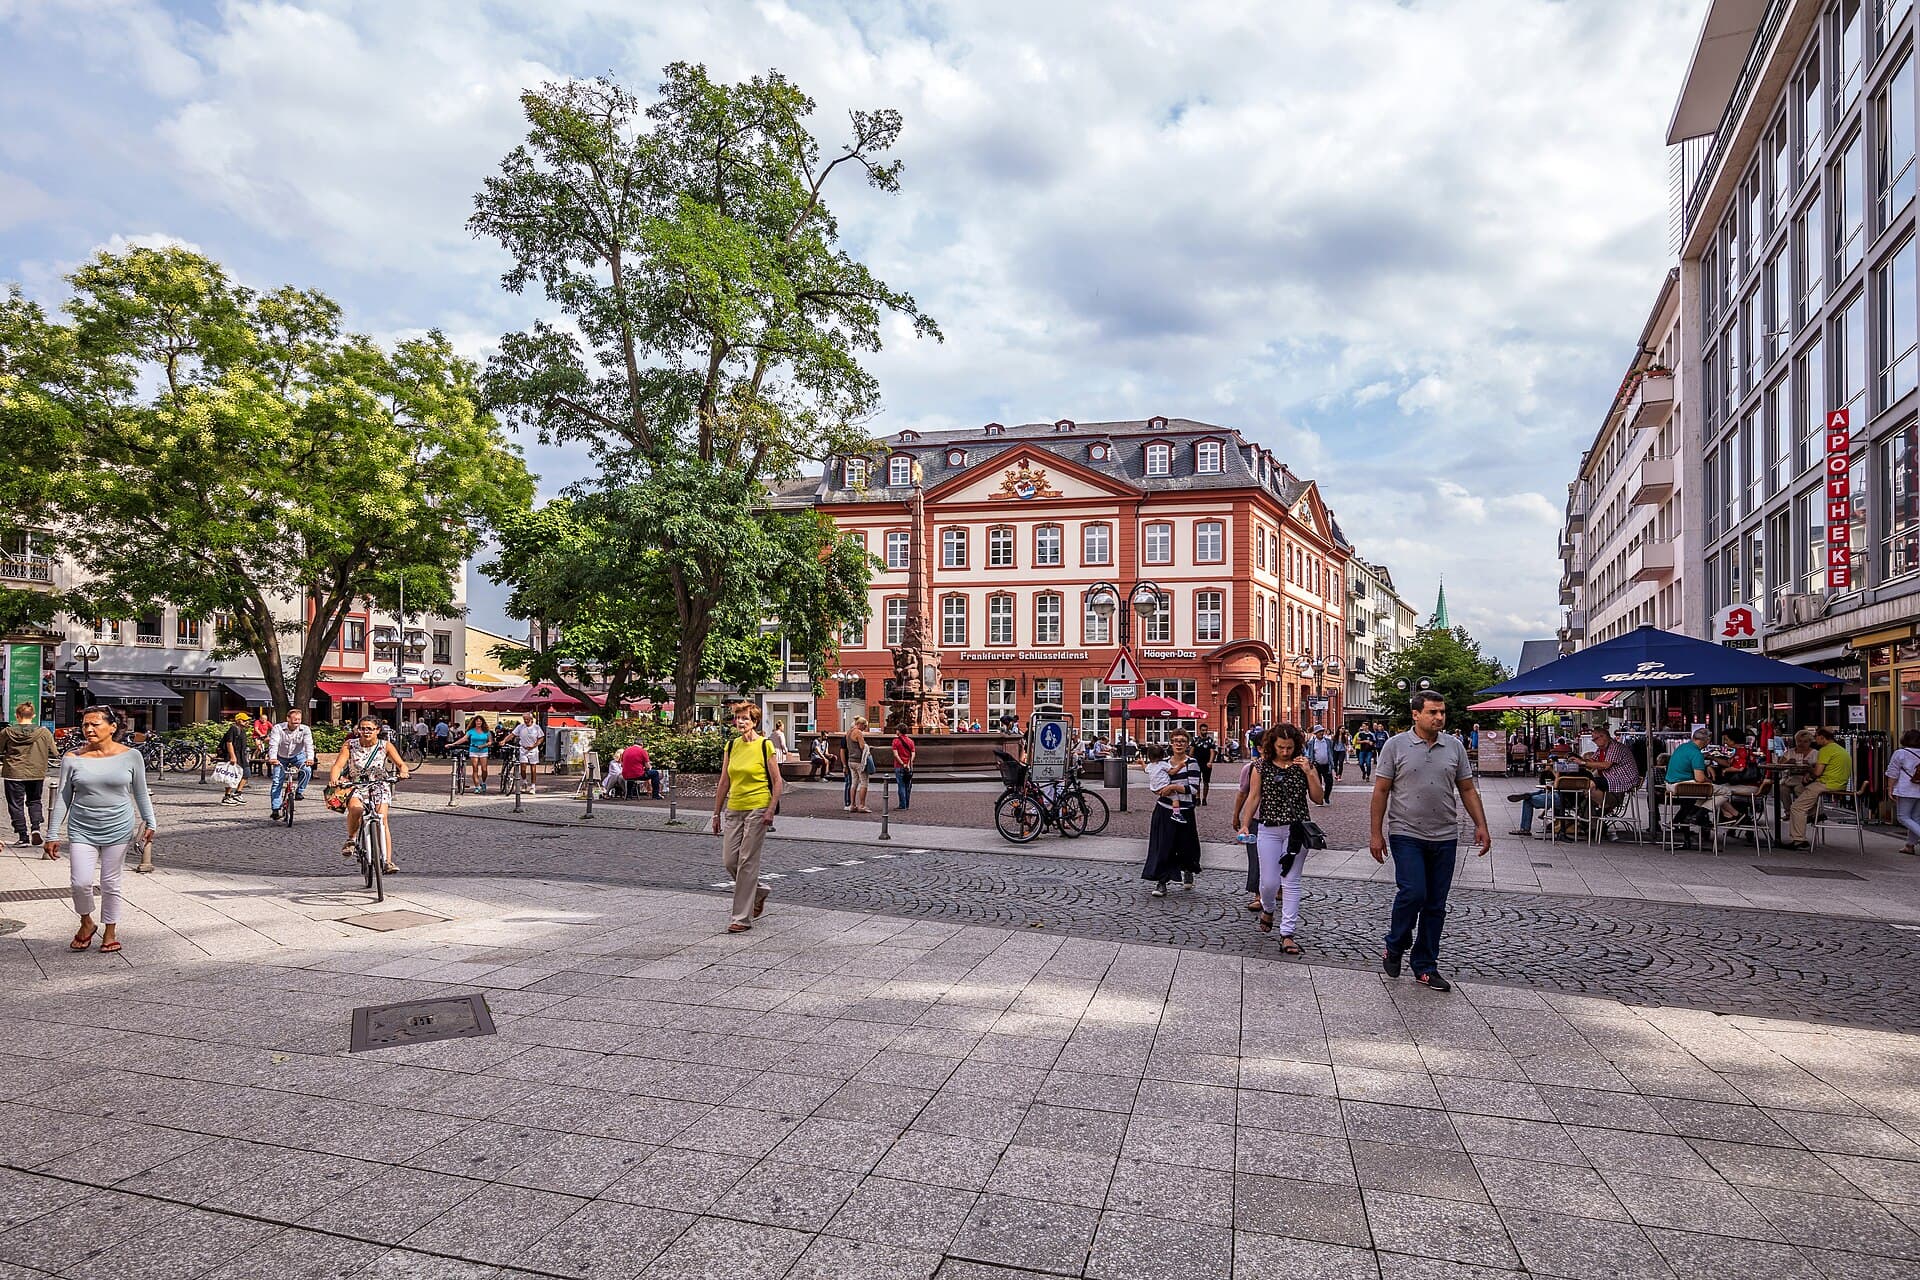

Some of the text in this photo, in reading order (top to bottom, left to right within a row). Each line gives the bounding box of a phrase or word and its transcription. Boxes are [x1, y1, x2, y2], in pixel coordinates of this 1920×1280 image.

[1830, 412, 1847, 585] APOTHEKE
[960, 650, 1088, 660] Frankfurter Schlüsseldienst
[1143, 649, 1197, 659] Häagen-Dazs
[1601, 671, 1695, 682] Tchibo
